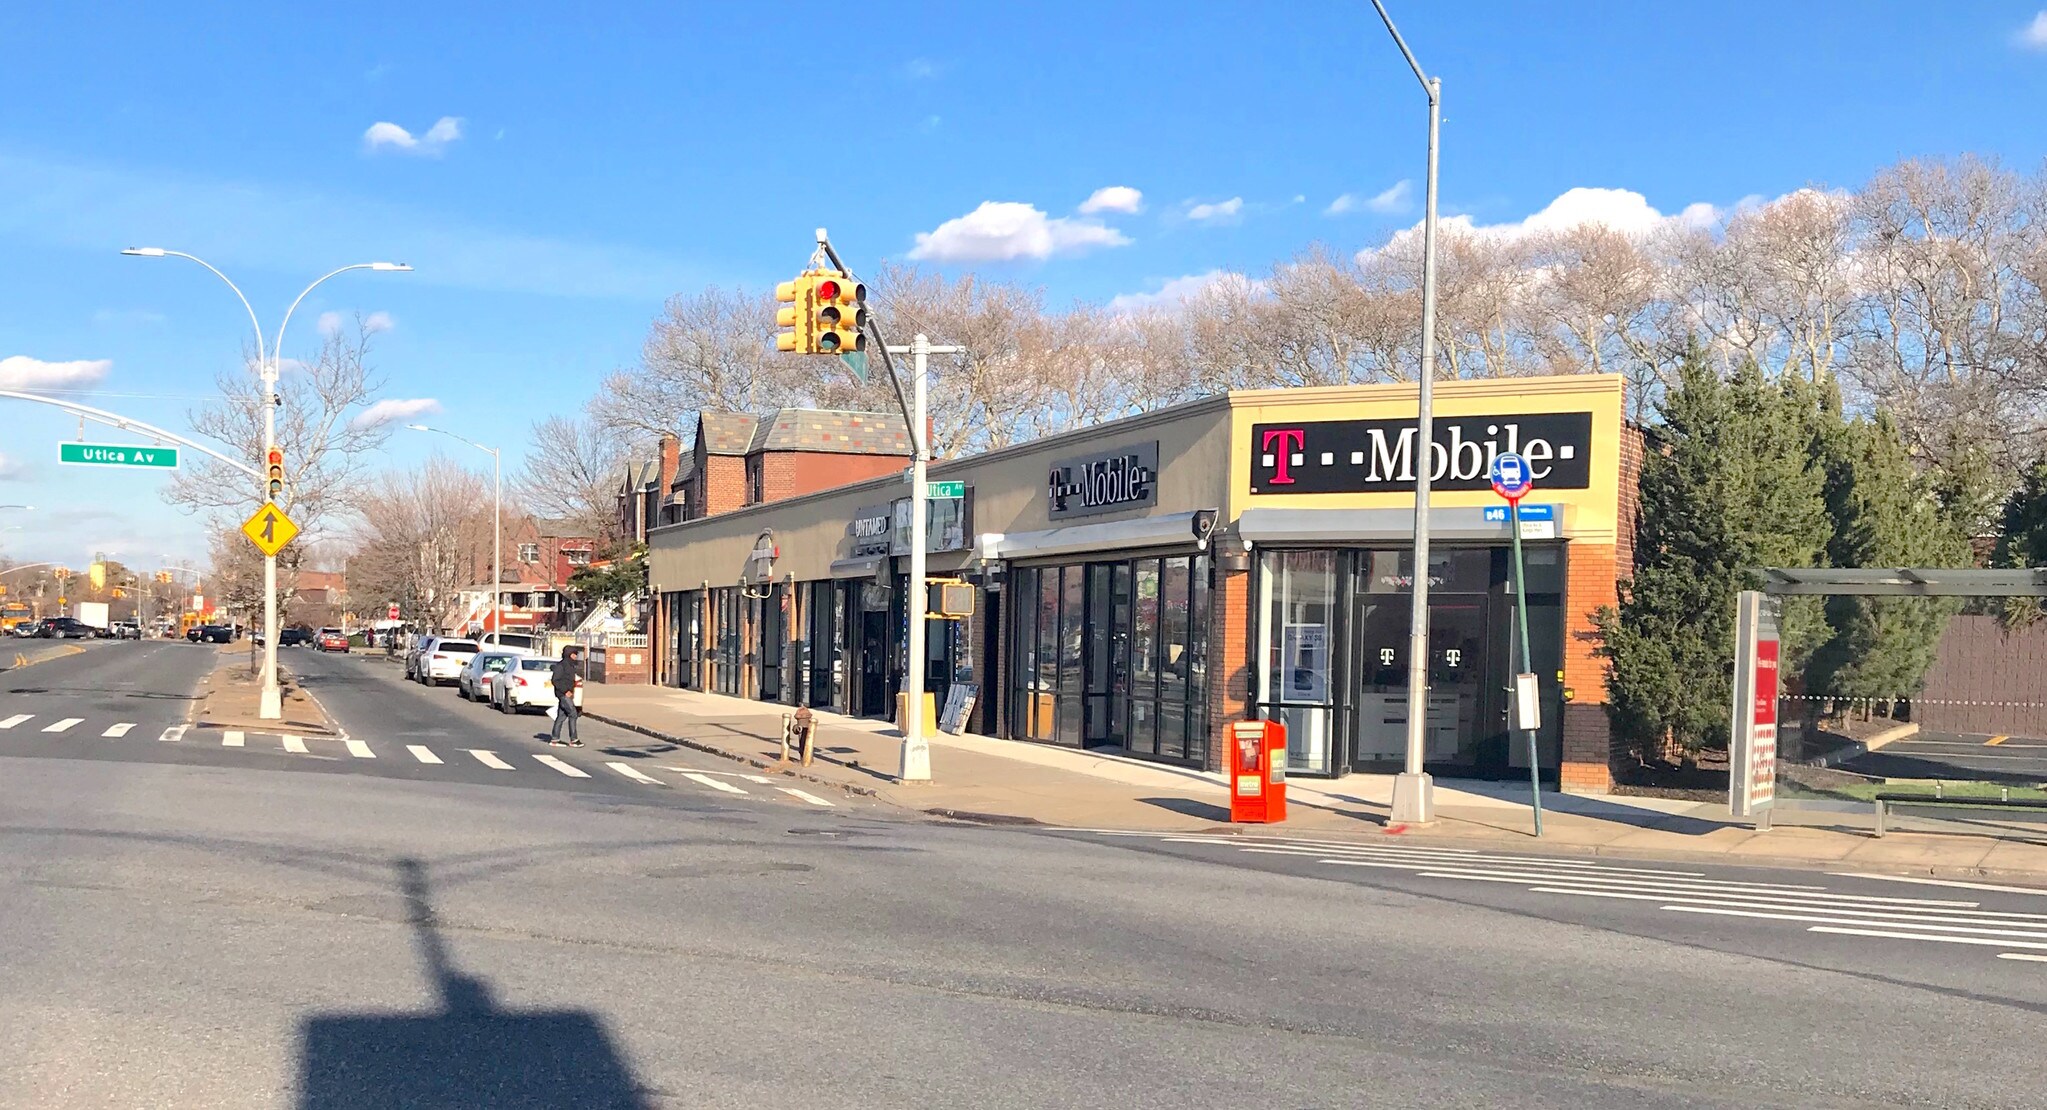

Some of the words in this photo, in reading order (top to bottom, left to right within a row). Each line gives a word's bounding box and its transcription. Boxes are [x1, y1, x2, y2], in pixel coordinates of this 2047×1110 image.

[83, 448, 125, 462] Utica
[133, 451, 155, 463] Av
[1080, 455, 1140, 507] Mobile
[926, 483, 951, 497] Utica
[1487, 509, 1505, 520] B46
